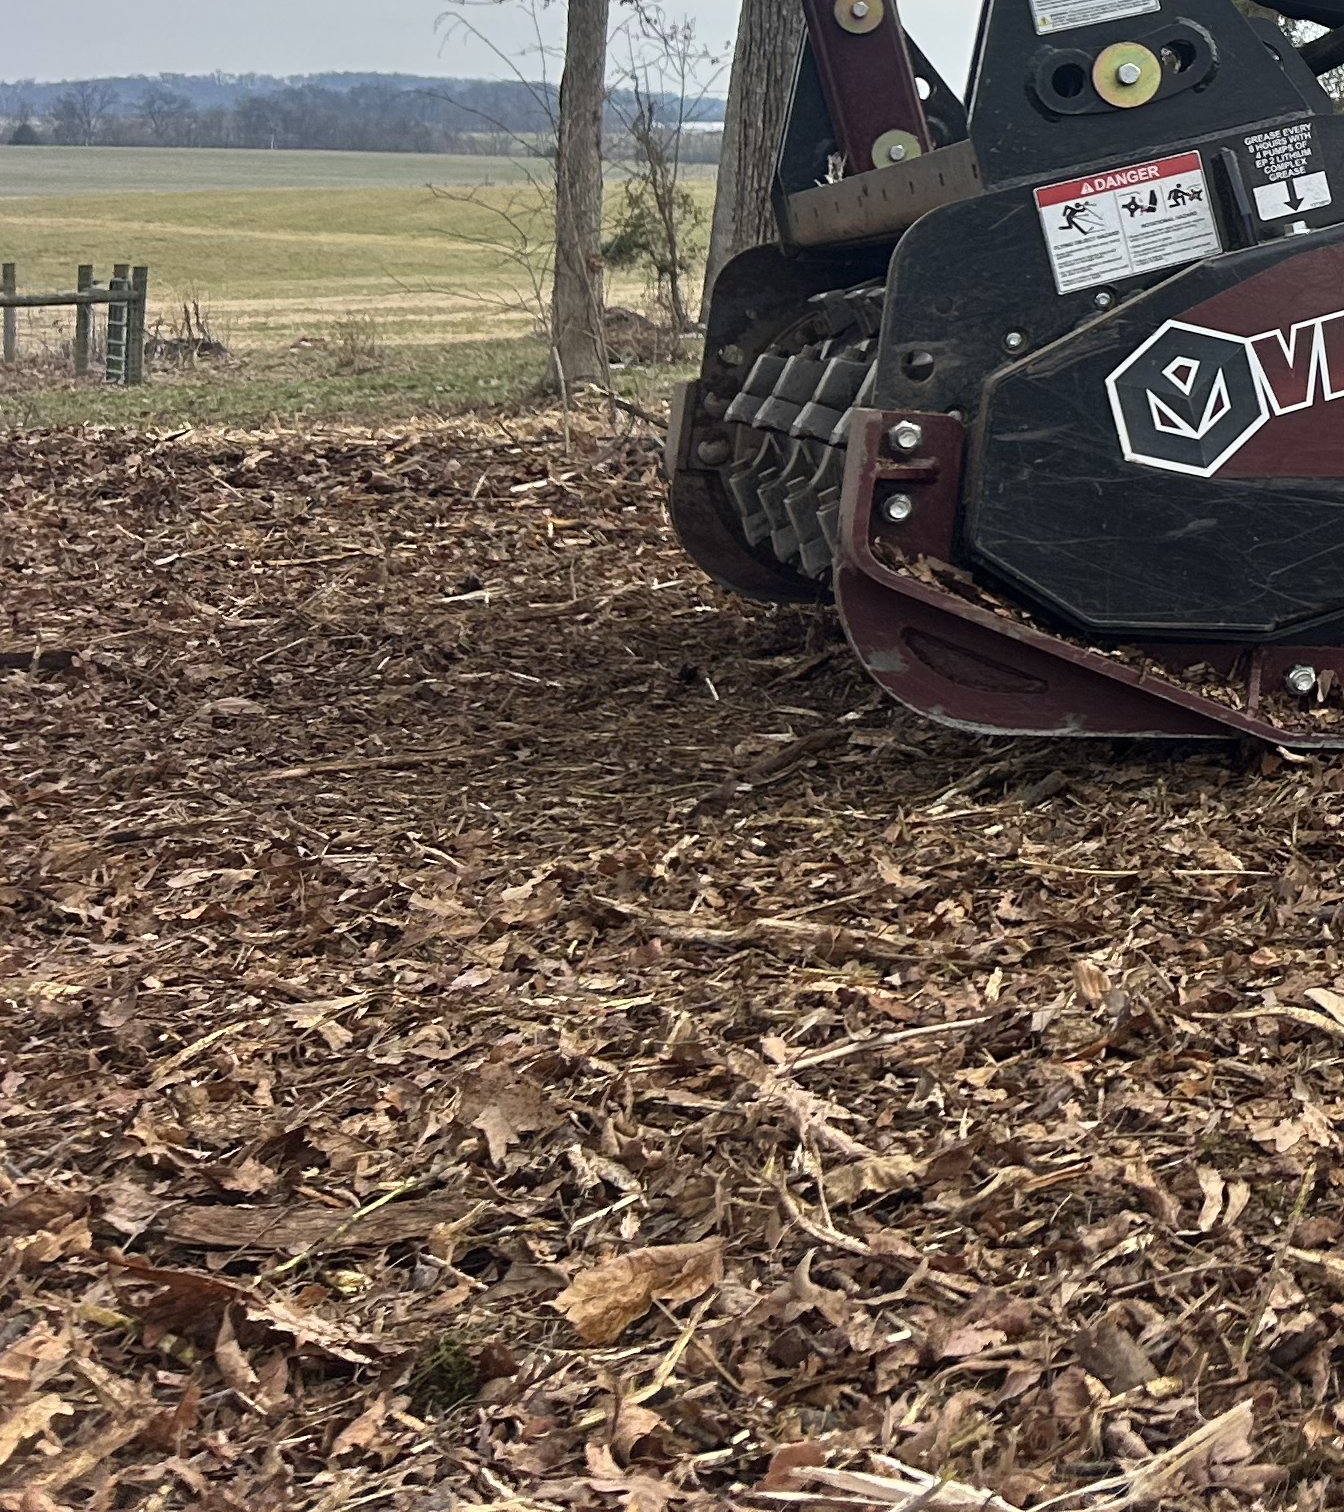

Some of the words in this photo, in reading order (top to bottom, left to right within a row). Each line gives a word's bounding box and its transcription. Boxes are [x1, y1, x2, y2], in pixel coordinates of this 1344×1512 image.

[1244, 130, 1281, 146] GREASE
[1282, 122, 1312, 137] EVERY
[1255, 137, 1287, 151] HOURS
[1288, 132, 1312, 143] WITH
[1255, 159, 1268, 168] EP
[1276, 148, 1312, 163] LITHIUM
[1262, 144, 1294, 158] PUMPS
[1295, 141, 1307, 150] OF
[1264, 157, 1308, 174] COMPLEX
[1269, 166, 1306, 182] GREASE
[1093, 165, 1160, 192] DANGER
